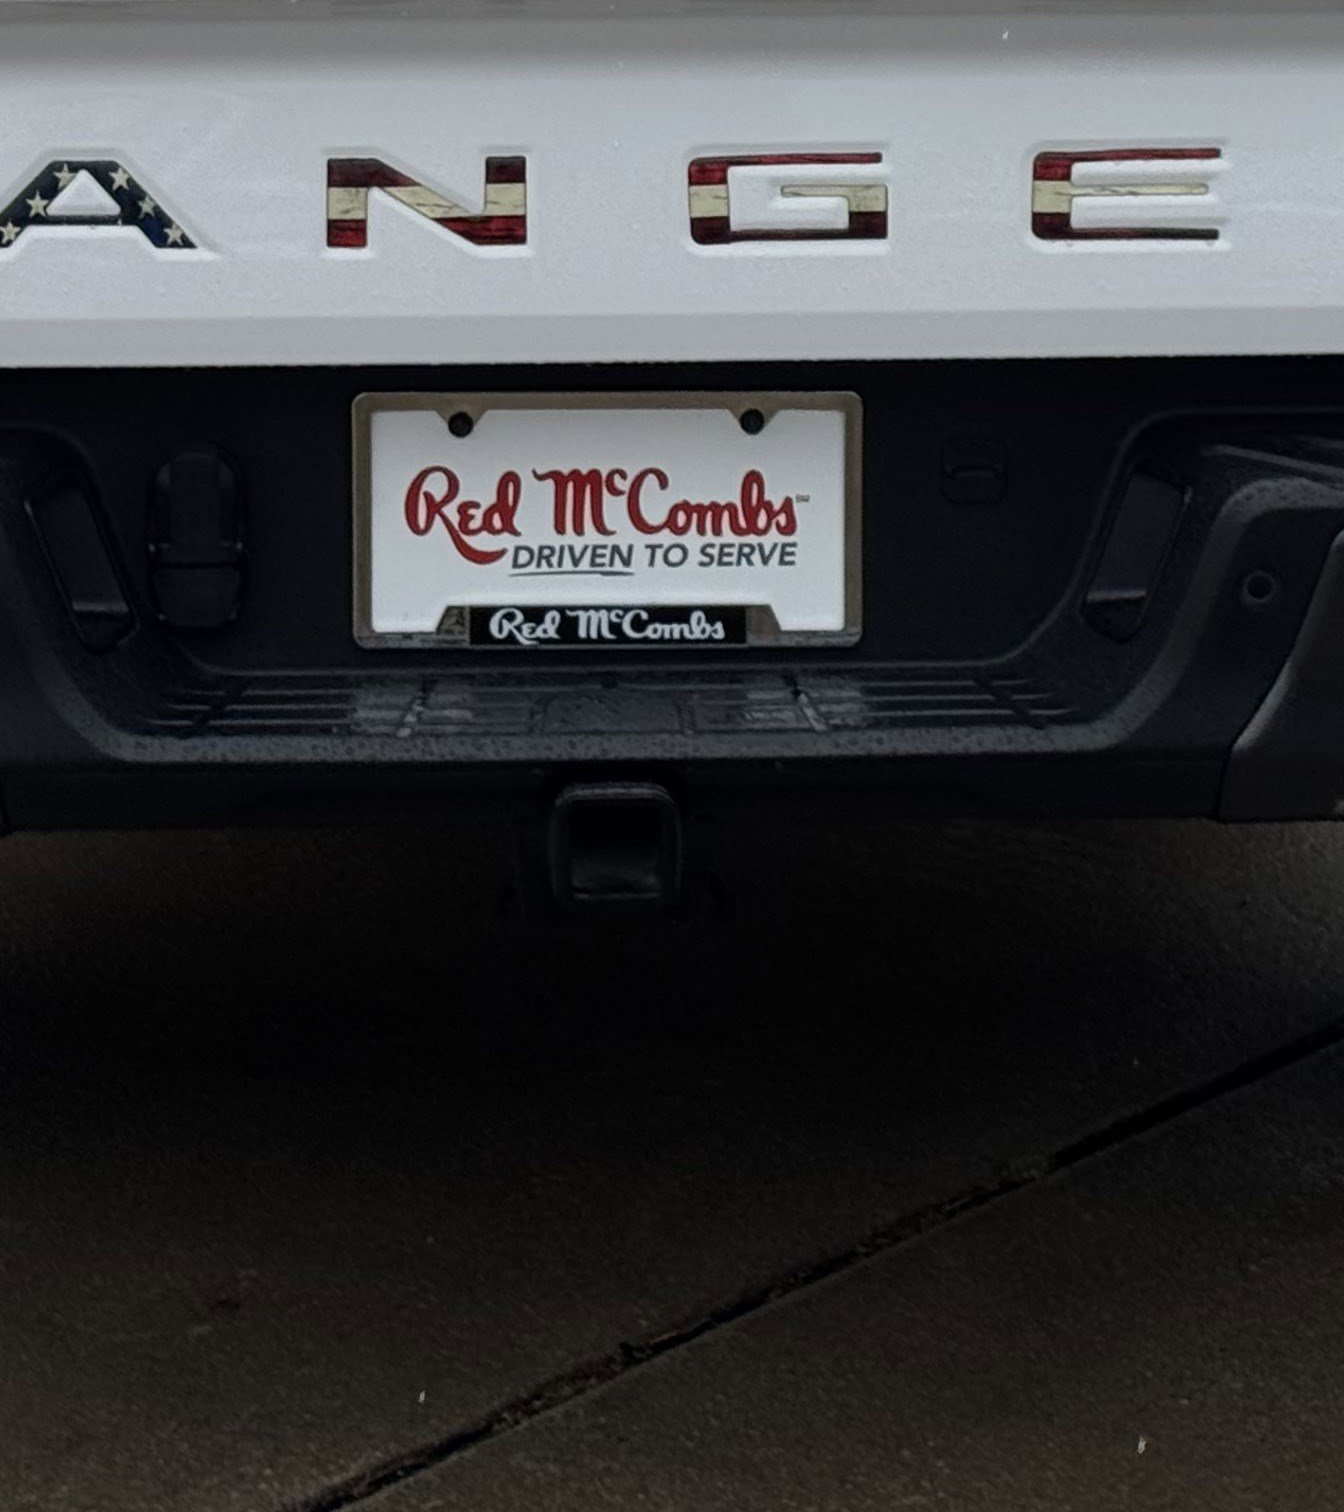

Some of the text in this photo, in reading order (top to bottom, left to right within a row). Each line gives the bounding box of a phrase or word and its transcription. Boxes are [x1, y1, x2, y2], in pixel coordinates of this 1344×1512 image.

[404, 465, 798, 565] Red McCombs
[510, 542, 799, 569] DRIVEN TO SERVE
[488, 607, 726, 646] Red McCombs
